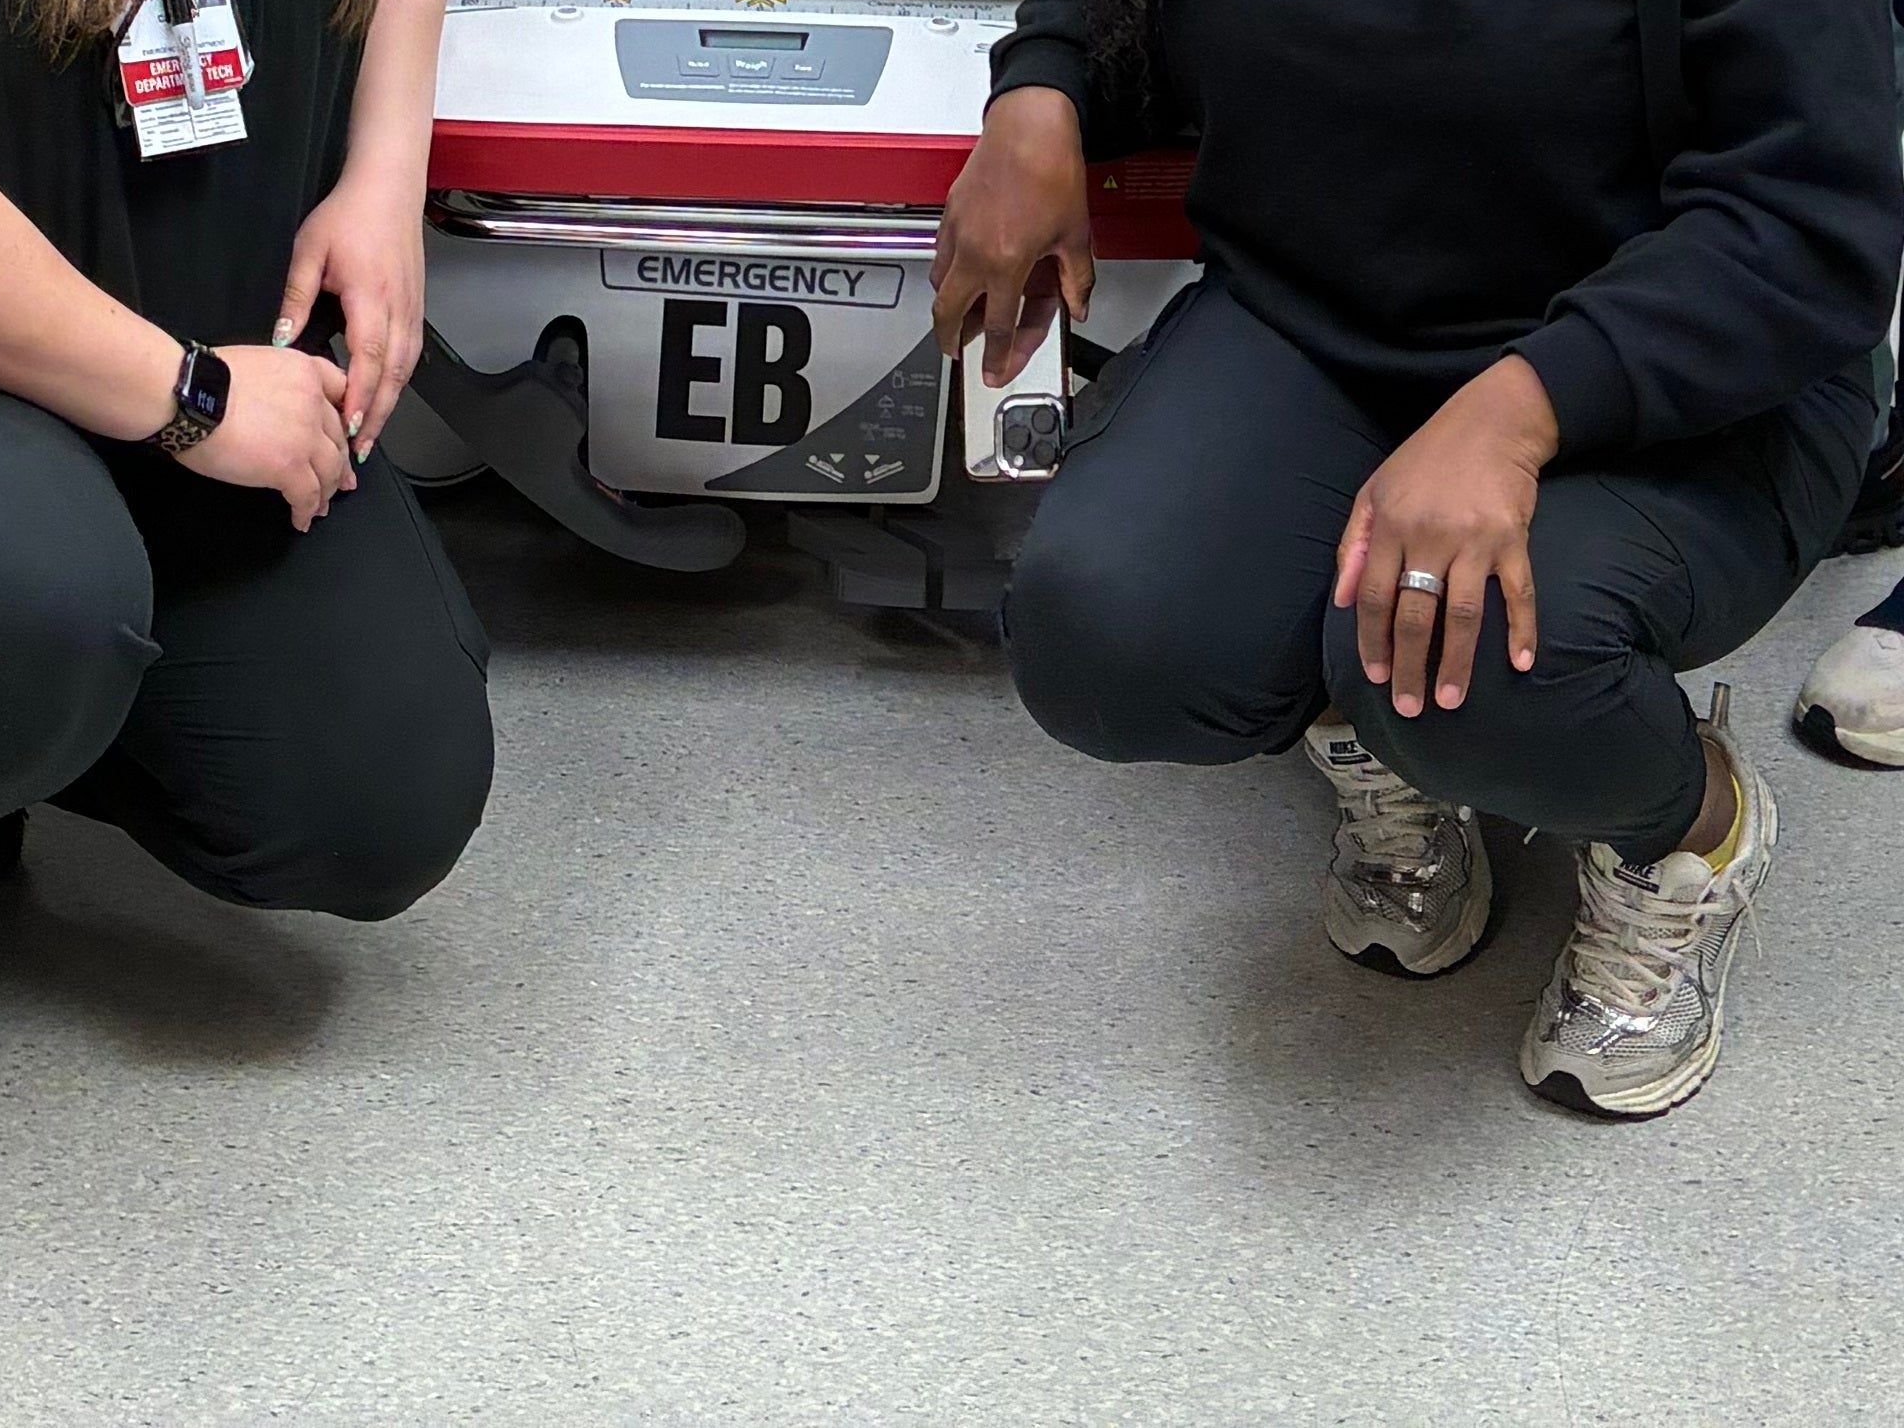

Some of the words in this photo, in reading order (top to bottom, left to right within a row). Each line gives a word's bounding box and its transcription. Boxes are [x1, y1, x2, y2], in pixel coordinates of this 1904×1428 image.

[149, 53, 213, 76] EMERCY
[207, 64, 234, 81] TECH
[636, 254, 867, 298] EMERGENCY
[655, 297, 812, 446] EB
